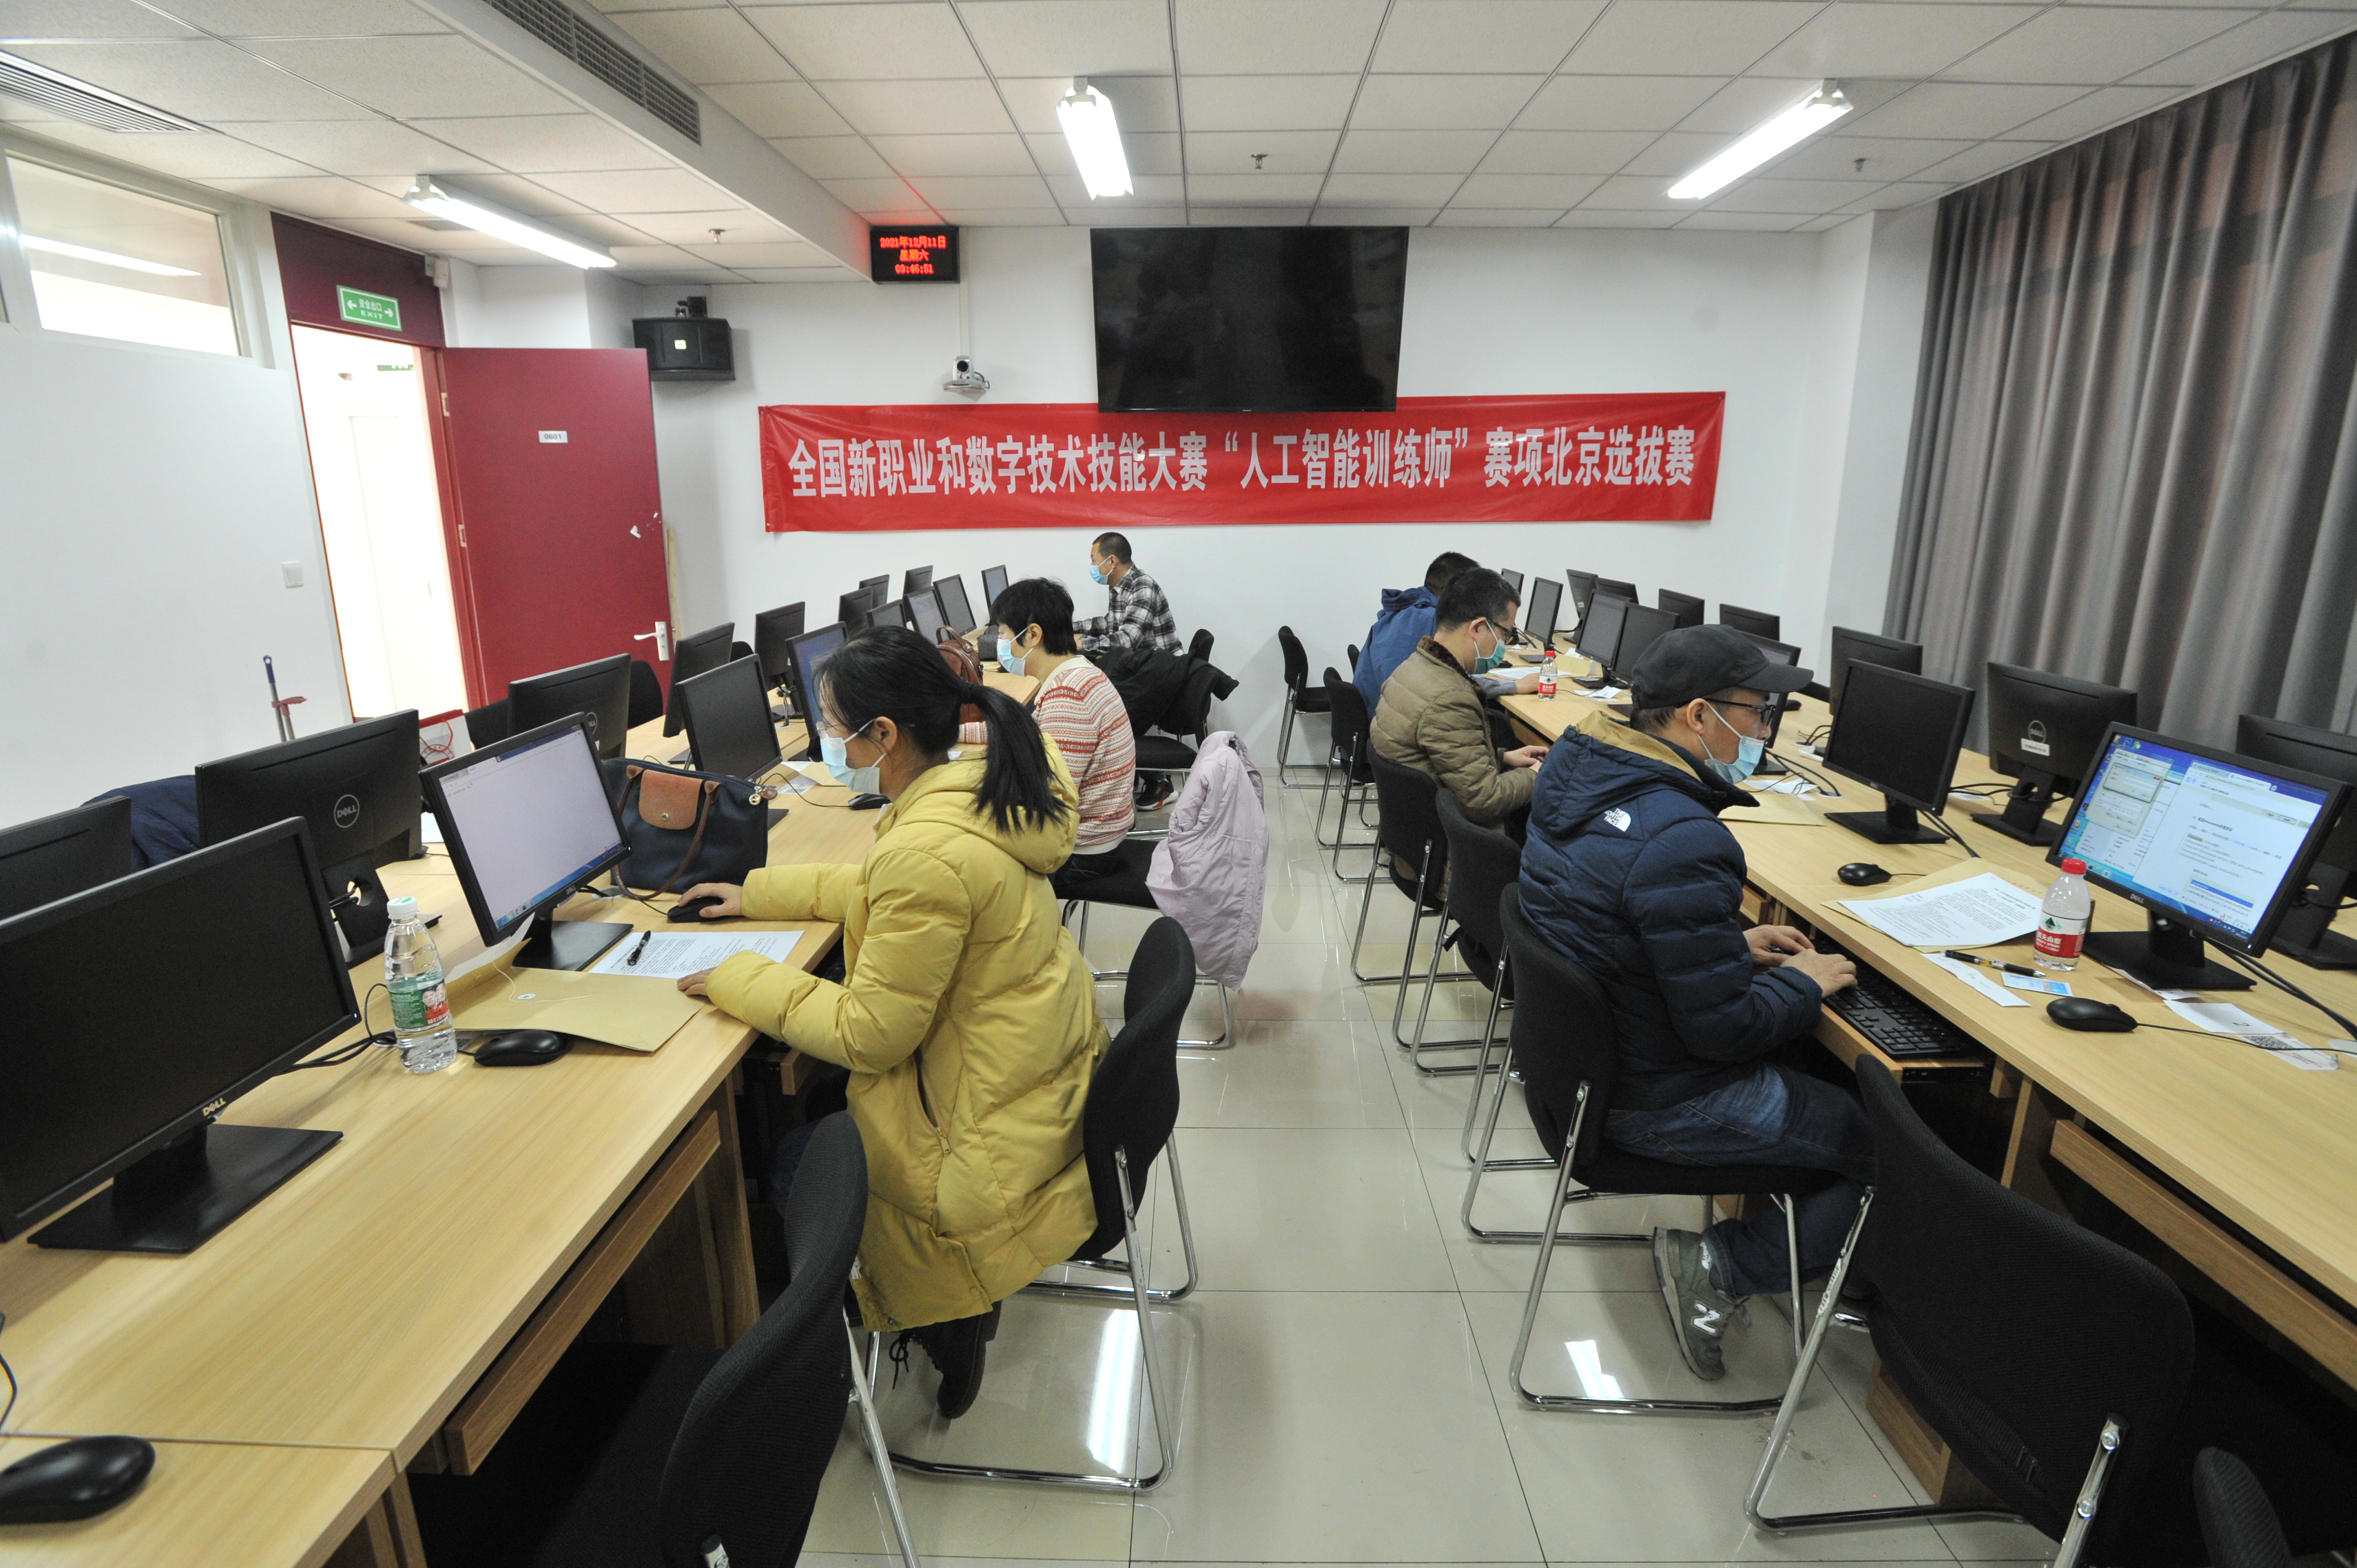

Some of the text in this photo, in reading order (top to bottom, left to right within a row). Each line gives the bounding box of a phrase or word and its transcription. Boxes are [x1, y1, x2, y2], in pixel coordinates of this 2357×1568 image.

[880, 235, 946, 249] 2021年12月11日
[899, 249, 929, 262] 星期六
[895, 264, 934, 274] 09:46:51
[358, 299, 382, 312] 安全出口
[361, 310, 383, 319] EXIT
[337, 805, 357, 818] DELL
[1603, 809, 1623, 822] NORTH
[1614, 808, 1625, 818] THE
[1604, 815, 1619, 827] FACE
[2130, 893, 2144, 904] DELL
[203, 1097, 227, 1116] DELL
